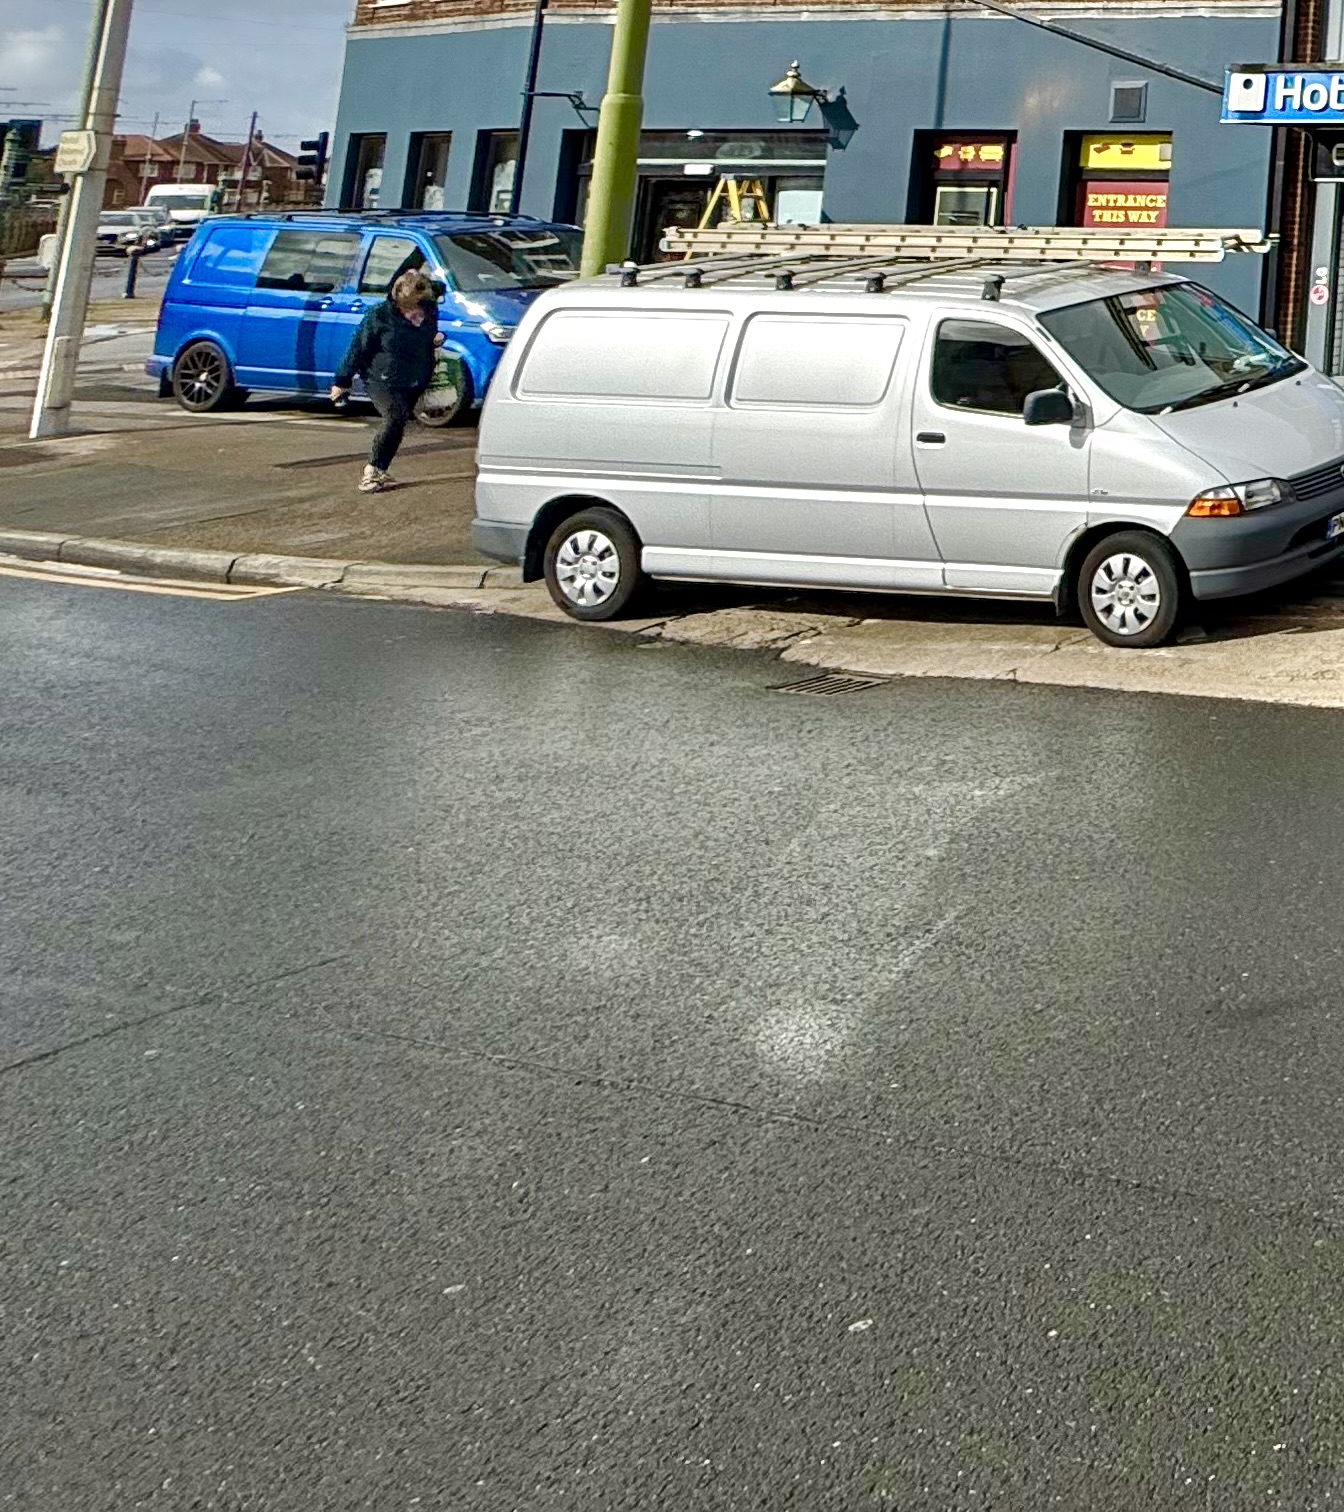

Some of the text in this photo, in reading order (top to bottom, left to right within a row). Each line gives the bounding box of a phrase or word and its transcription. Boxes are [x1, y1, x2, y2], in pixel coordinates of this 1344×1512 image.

[1087, 194, 1167, 208] ENTRANCE
[1092, 210, 1160, 223] THIS WAY
